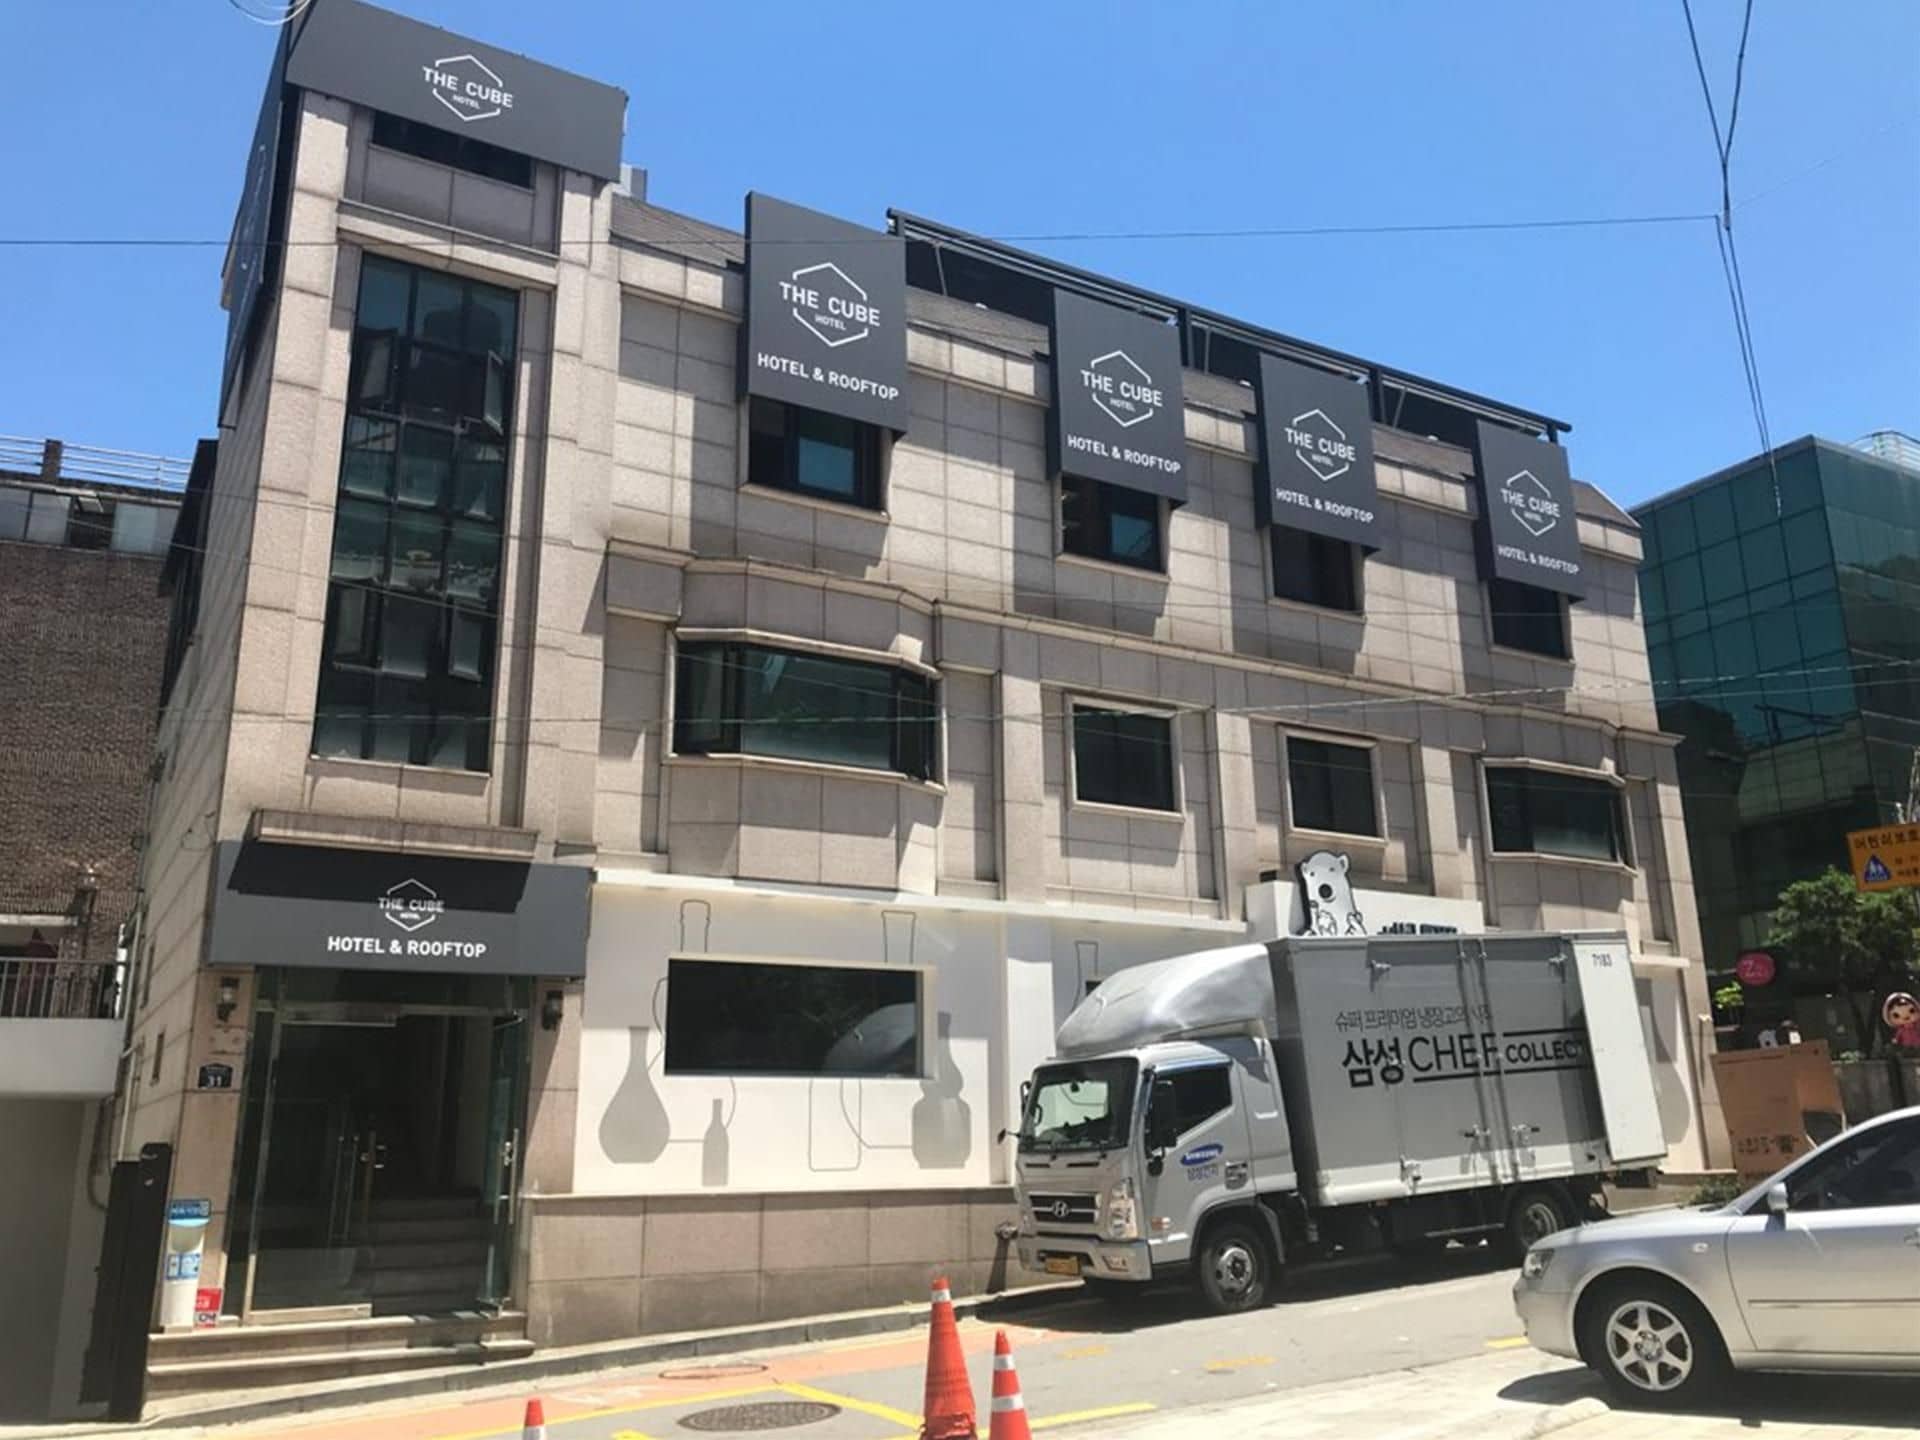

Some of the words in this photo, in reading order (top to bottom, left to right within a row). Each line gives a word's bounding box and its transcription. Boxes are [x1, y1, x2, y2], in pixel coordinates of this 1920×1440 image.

[422, 66, 458, 91] THE
[466, 81, 513, 108] CUBE
[779, 281, 819, 309] THE
[828, 297, 880, 326] CUBE
[814, 314, 846, 330] HOTEL
[757, 352, 809, 378] HOTEL
[812, 367, 824, 382] &
[828, 371, 899, 400] ROOFTOP
[1080, 369, 1113, 393] THE
[1120, 381, 1163, 407] CUBE
[1067, 434, 1108, 456] HOTEL
[1112, 446, 1121, 459] &
[1124, 449, 1181, 474] ROOFTOP
[1284, 427, 1313, 449] THE
[1318, 438, 1356, 462] CUBE
[1276, 488, 1312, 508] HOTEL
[1314, 498, 1322, 510] &
[1324, 501, 1374, 523] ROOFTOP
[1501, 487, 1526, 508] THE
[1528, 496, 1560, 518] CUBE
[1497, 544, 1528, 562] HOTEL
[378, 897, 404, 911] THE
[409, 899, 445, 913] CUBE
[327, 935, 385, 954] HOTEL
[389, 939, 403, 955] &
[407, 940, 487, 958] ROOFTOP
[1342, 1036, 1404, 1088] 삼성
[1408, 1032, 1498, 1072] CHEF
